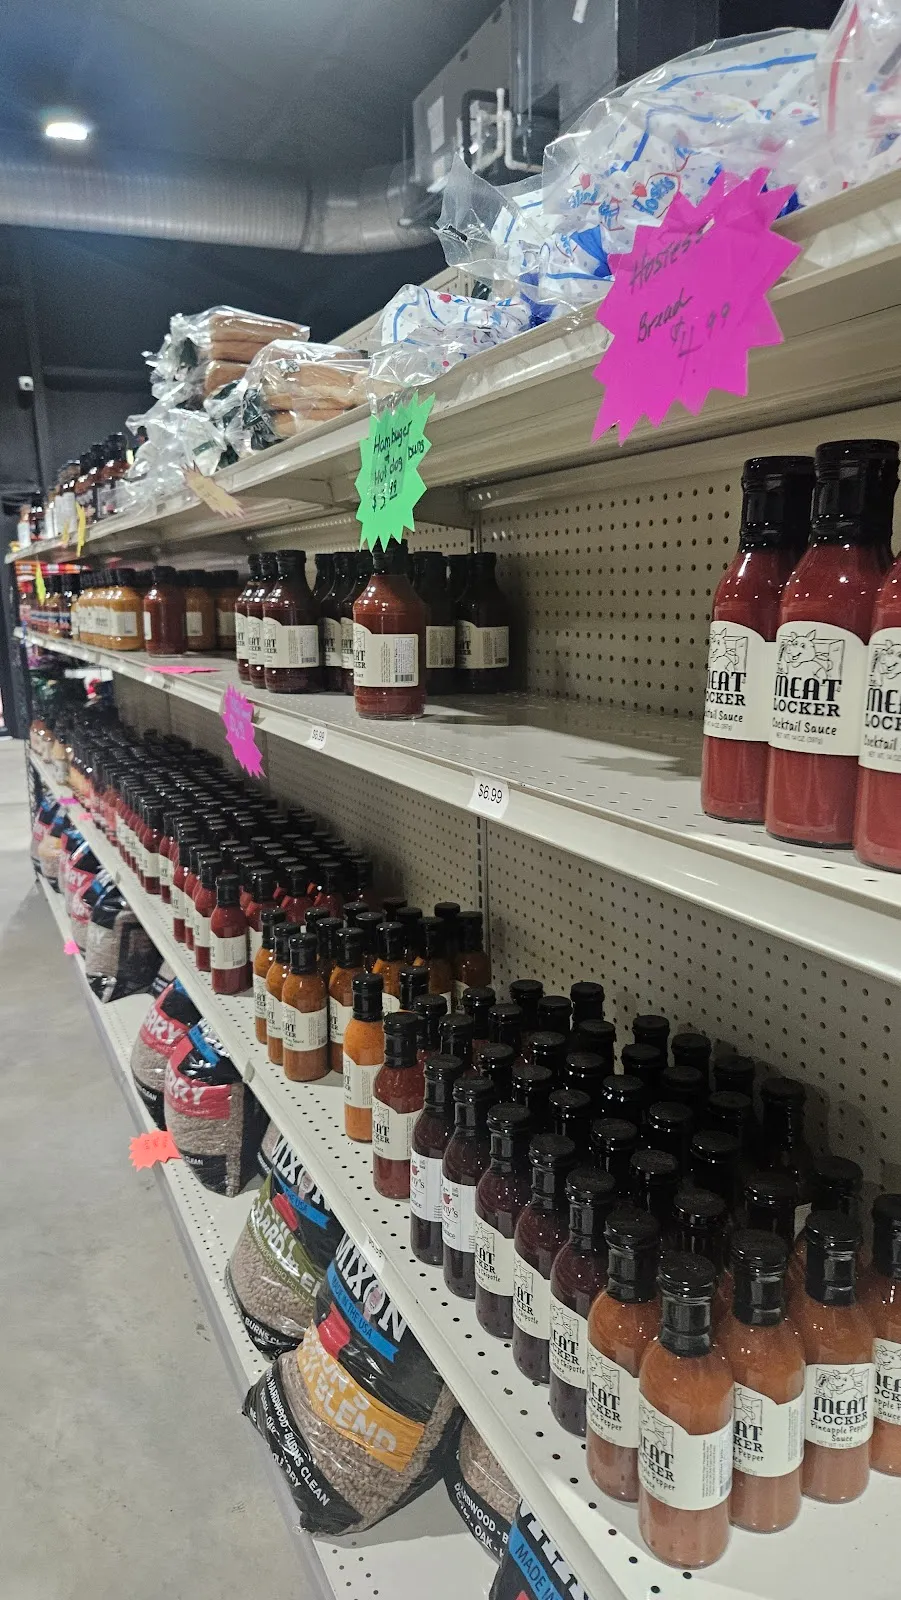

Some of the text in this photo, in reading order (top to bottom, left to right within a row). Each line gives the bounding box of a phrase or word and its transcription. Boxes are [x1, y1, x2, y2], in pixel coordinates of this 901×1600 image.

[707, 669, 747, 692] EAT
[774, 674, 842, 702] MEAT
[773, 698, 841, 717] LOCKER
[866, 688, 901, 714] ME
[718, 710, 744, 723] Sauce
[772, 716, 837, 736] Cocktail Sauce
[477, 783, 503, 804] $6.99
[476, 1242, 496, 1265] EAT
[477, 1259, 496, 1274] KER
[245, 1316, 269, 1339] BURNS
[346, 1305, 360, 1323] THE
[358, 1319, 373, 1339] USA
[552, 1329, 579, 1355] EAT
[551, 1342, 580, 1366] CKER
[592, 1381, 620, 1410] EAT
[813, 1394, 868, 1416] MEAT
[589, 1396, 622, 1423] CKER
[812, 1410, 868, 1426] LOCKER
[877, 1407, 901, 1421] Sauce
[734, 1420, 763, 1442] AT
[810, 1419, 847, 1434] Pineapple
[831, 1434, 853, 1442] Sauce
[267, 1379, 288, 1428] HARDWOOD
[284, 1431, 304, 1468] BURNS
[300, 1466, 330, 1507] CLEAN
[733, 1434, 763, 1453] KER
[738, 1447, 764, 1462] Pepper
[641, 1451, 675, 1482] CKER
[474, 1525, 494, 1549] OAK
[515, 1542, 547, 1592] MADE
